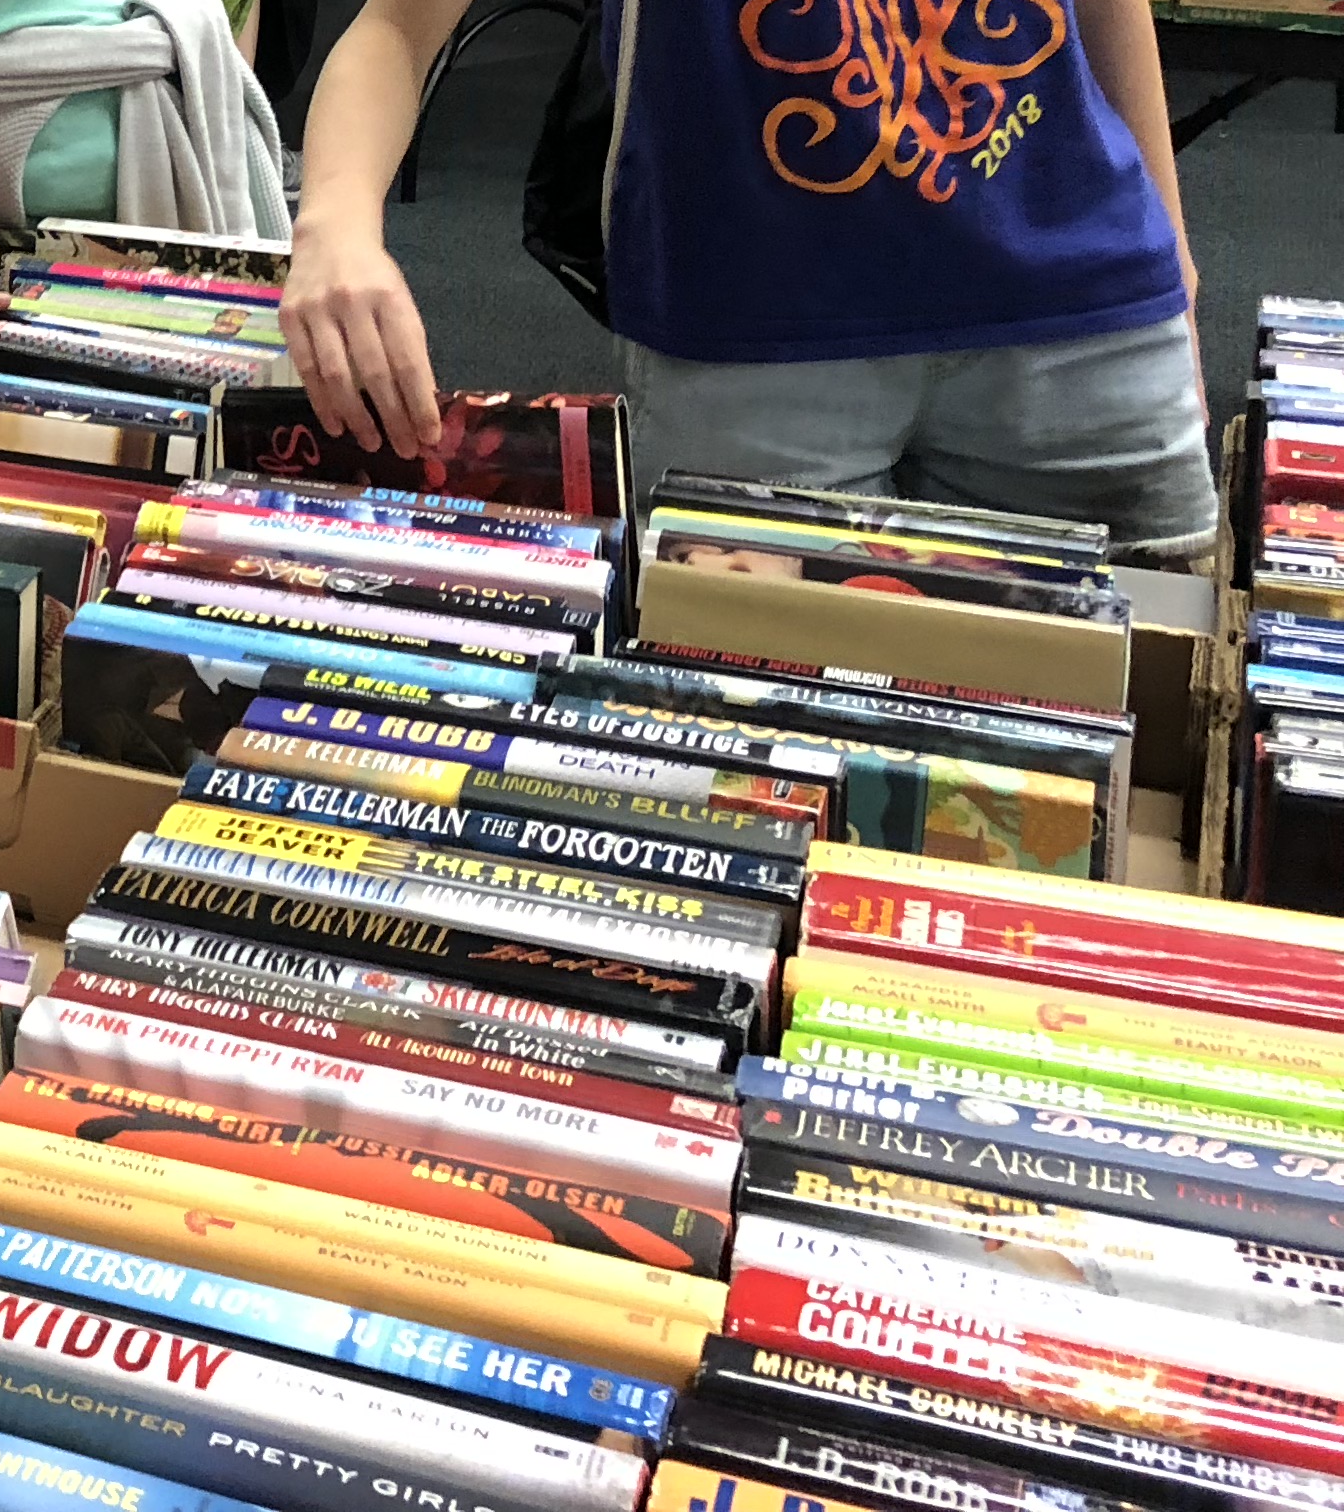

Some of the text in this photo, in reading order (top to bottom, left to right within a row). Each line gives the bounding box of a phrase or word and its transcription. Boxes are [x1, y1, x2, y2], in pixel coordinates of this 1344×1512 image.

[971, 92, 1045, 180] 2018
[360, 485, 486, 515] HOLD FAST
[478, 522, 575, 549] KATHRYN
[354, 674, 433, 700] WIEHL
[510, 701, 580, 730] EYES
[242, 730, 445, 781] FAYE KELLERMAN
[279, 703, 497, 754] J. D. ROBB
[559, 752, 657, 780] DEATH
[203, 768, 733, 881] FAYE KELLERMAN THE FORGOTTEN
[473, 770, 757, 831] BLINDMAN'S BLUFF
[215, 828, 345, 862] DEAVER
[219, 815, 356, 848] JEFFERY
[112, 867, 453, 958] PATRICIA CORNWELL
[116, 921, 345, 984] TONY HILLERMAN
[72, 971, 339, 1040] MARY HIGGINS CLARK
[108, 949, 423, 1022] MARY HIGGINS CLARK
[178, 976, 347, 1021] ALAFAIR BURKE
[58, 1008, 603, 1137] HANK PHILLIPPI RYAN SAY NO MORE
[472, 1033, 587, 1071] in White
[1174, 1036, 1323, 1070] BEAUTY SALON
[22, 1077, 627, 1218] THE HANGING GIRL JUSSI ADLER-OLSEN
[793, 1109, 1156, 1202] JEFFREY ARCHER
[0, 1232, 188, 1304] PATTERSON
[388, 1330, 474, 1373] SEE
[481, 1348, 572, 1399] HER
[806, 1278, 1028, 1347] CATHERINE
[752, 1349, 1079, 1448] MICHAEL CONNELLY
[207, 1430, 360, 1486] PRETTY
